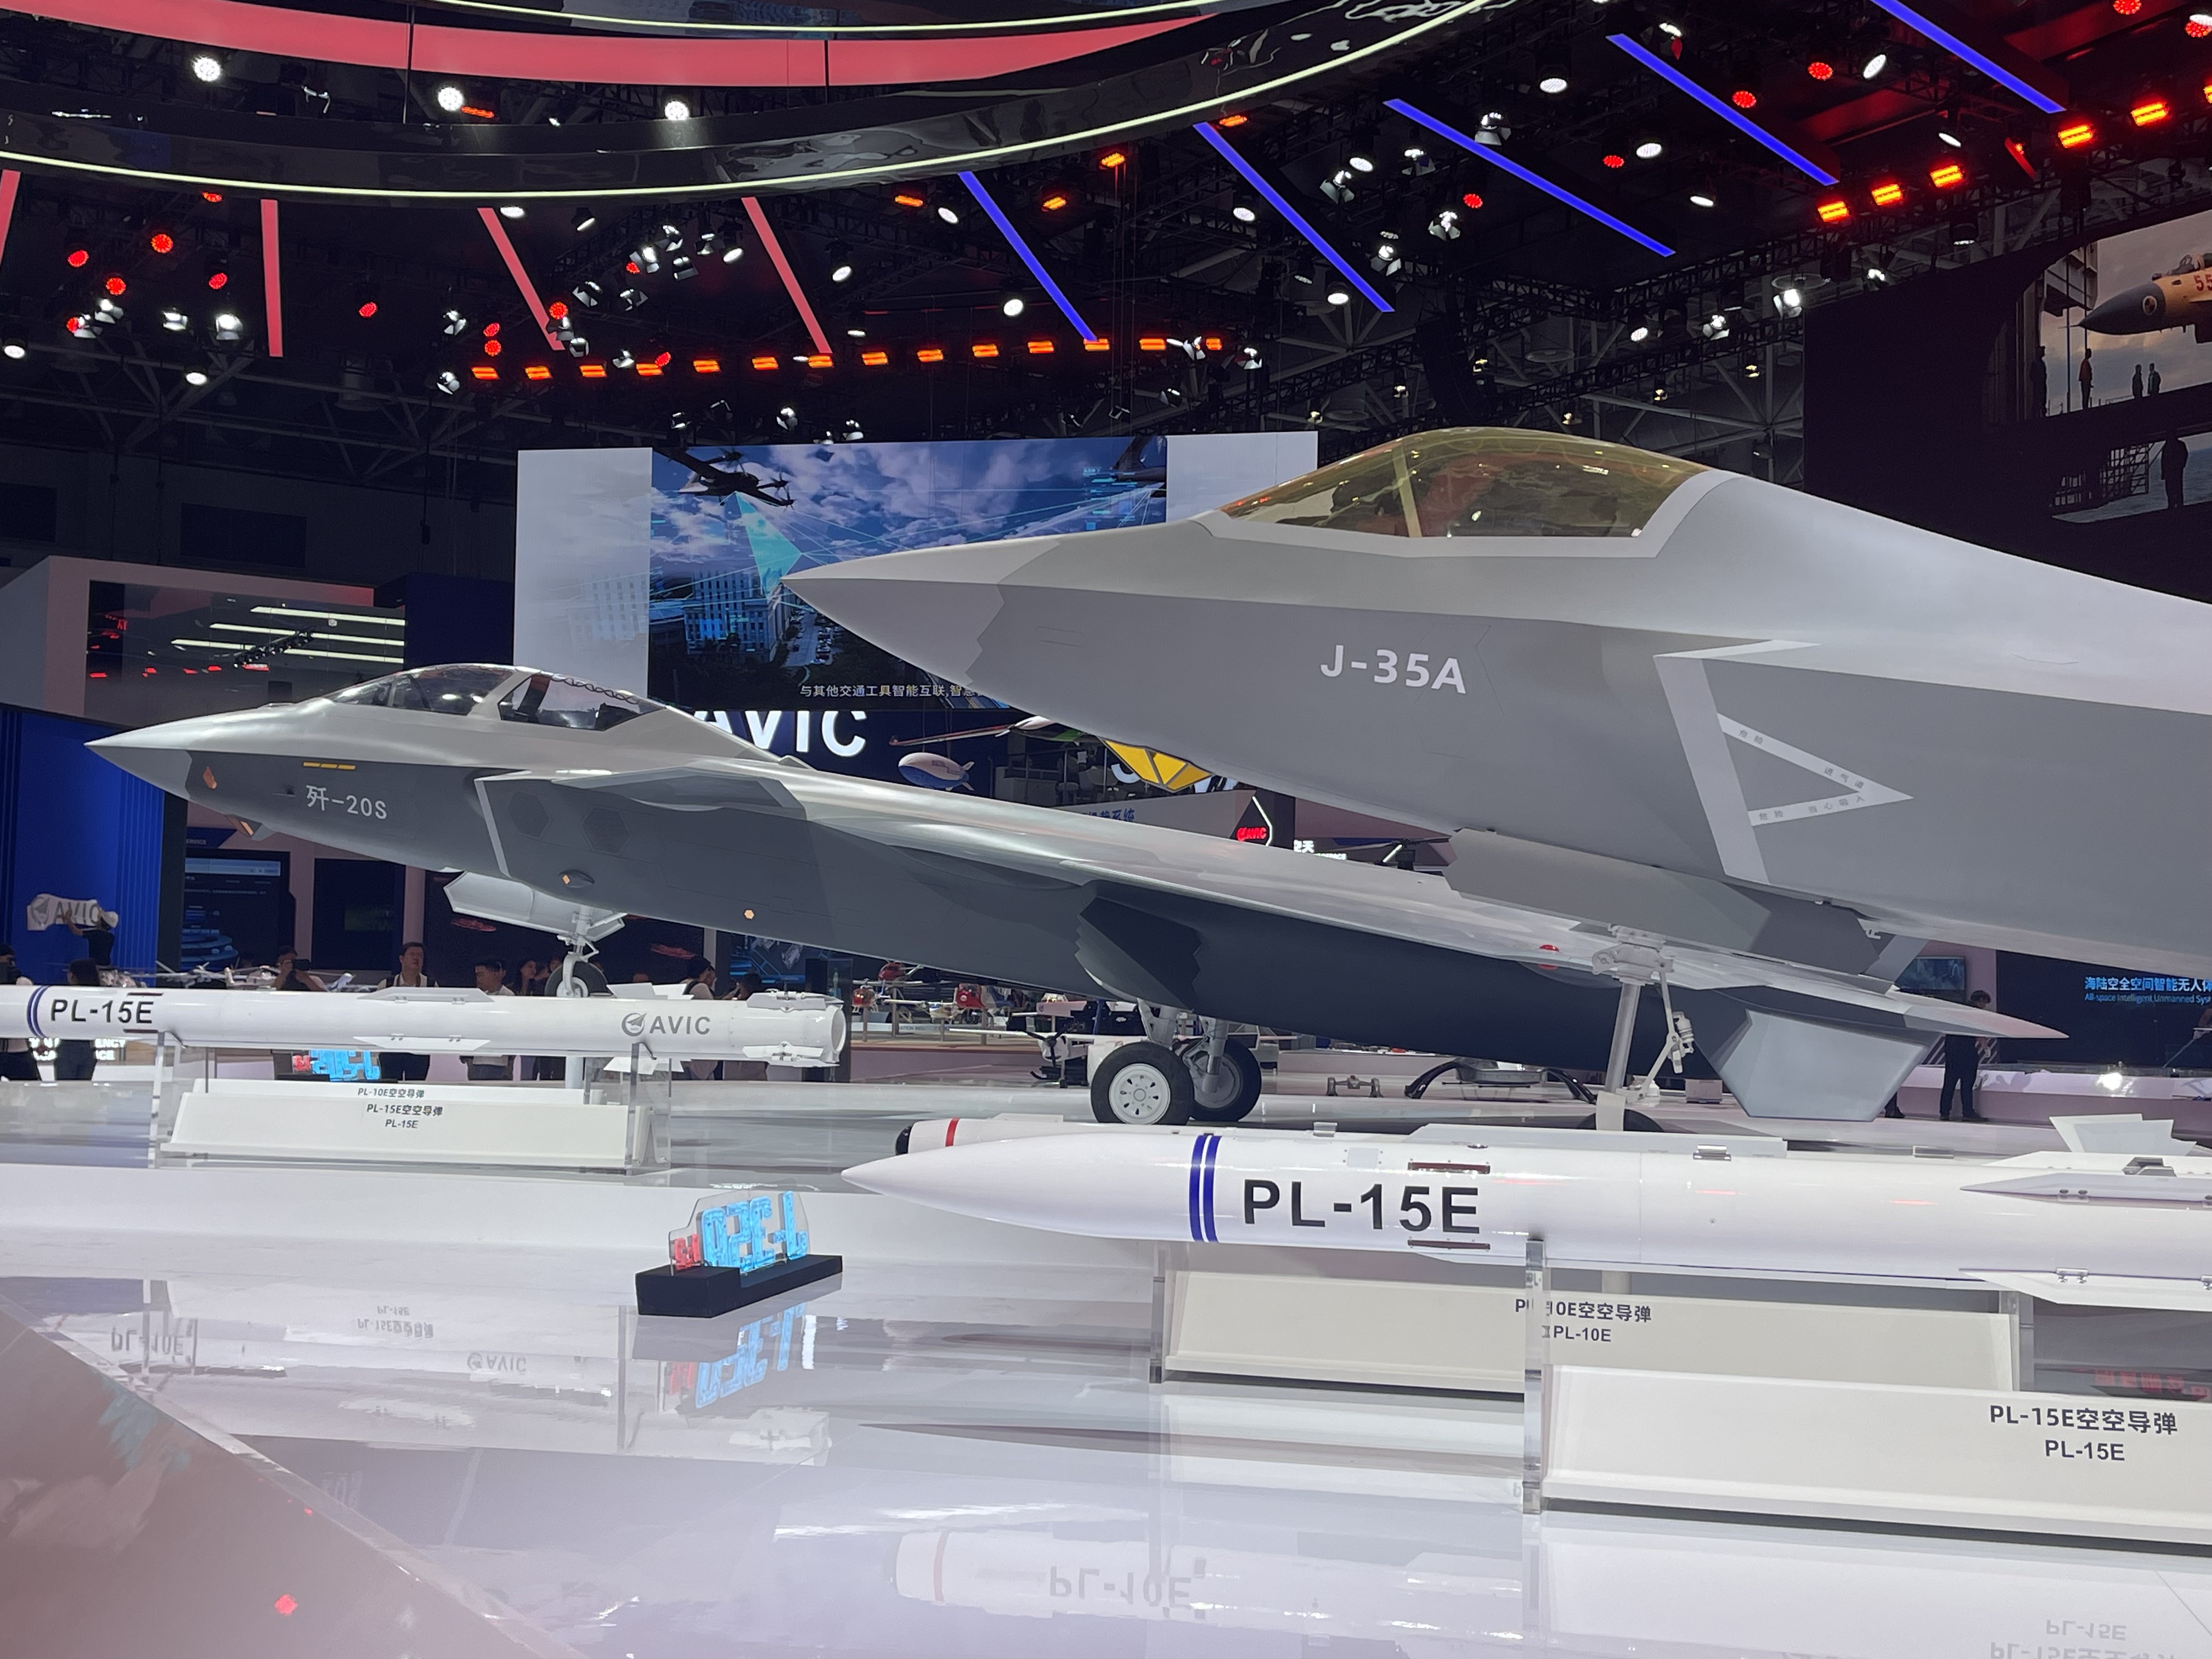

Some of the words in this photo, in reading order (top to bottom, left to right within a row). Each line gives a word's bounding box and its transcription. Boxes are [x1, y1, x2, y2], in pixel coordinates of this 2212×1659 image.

[1321, 645, 1466, 694] J-35A
[306, 785, 387, 819] 歼-20S
[51, 999, 154, 1024] PL-15E
[650, 1016, 710, 1035] AVIC
[366, 1104, 443, 1116] PL-15E空空导弹
[385, 1119, 419, 1128] PL-15E
[1244, 1179, 1480, 1234] PL-15E
[1554, 1325, 1611, 1342] PL-10E
[1990, 1404, 2178, 1435] PL-15E空空导弹
[2045, 1439, 2125, 1461] PL-15E
